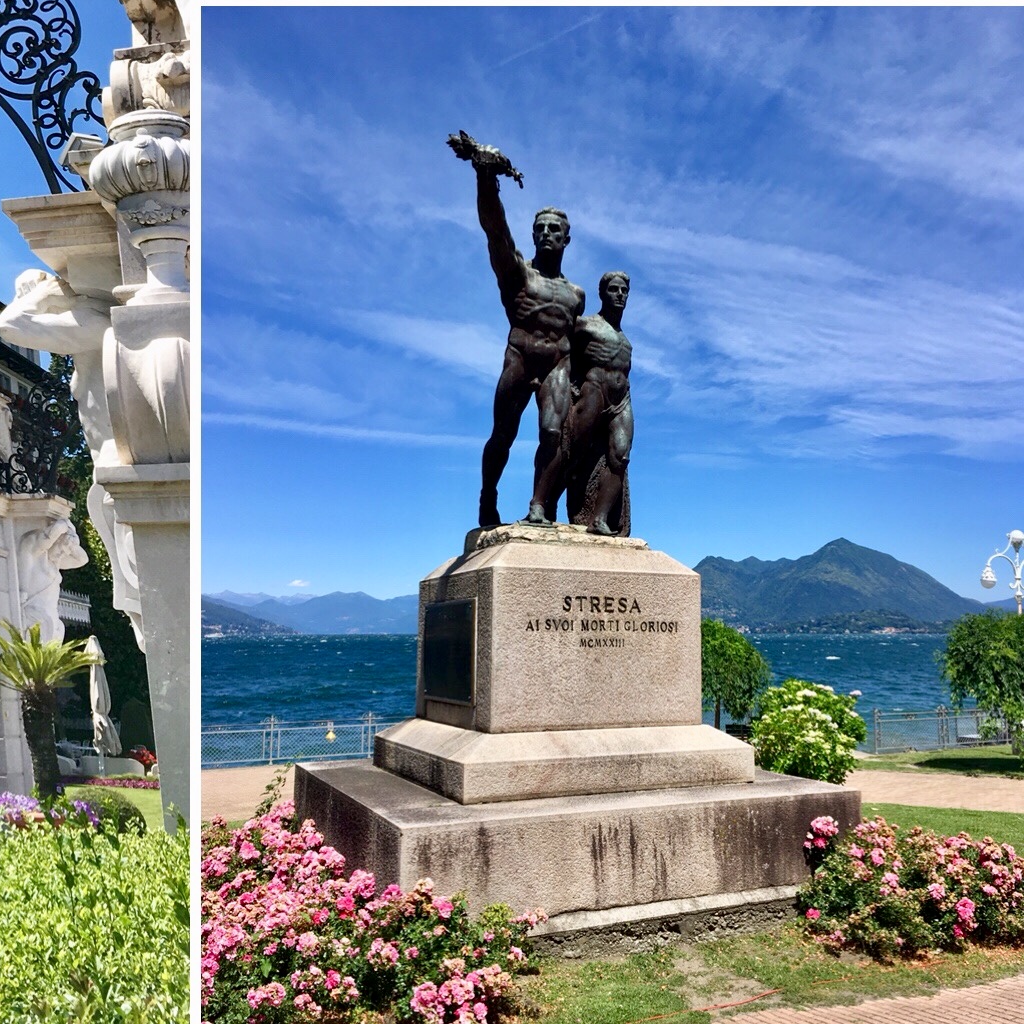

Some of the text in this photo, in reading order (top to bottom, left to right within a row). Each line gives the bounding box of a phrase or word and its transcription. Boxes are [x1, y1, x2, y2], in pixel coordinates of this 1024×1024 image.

[562, 596, 642, 614] STRESA
[525, 619, 679, 633] AI SVOI MORTI GLORIOSI
[579, 638, 625, 649] MCMXXIII
